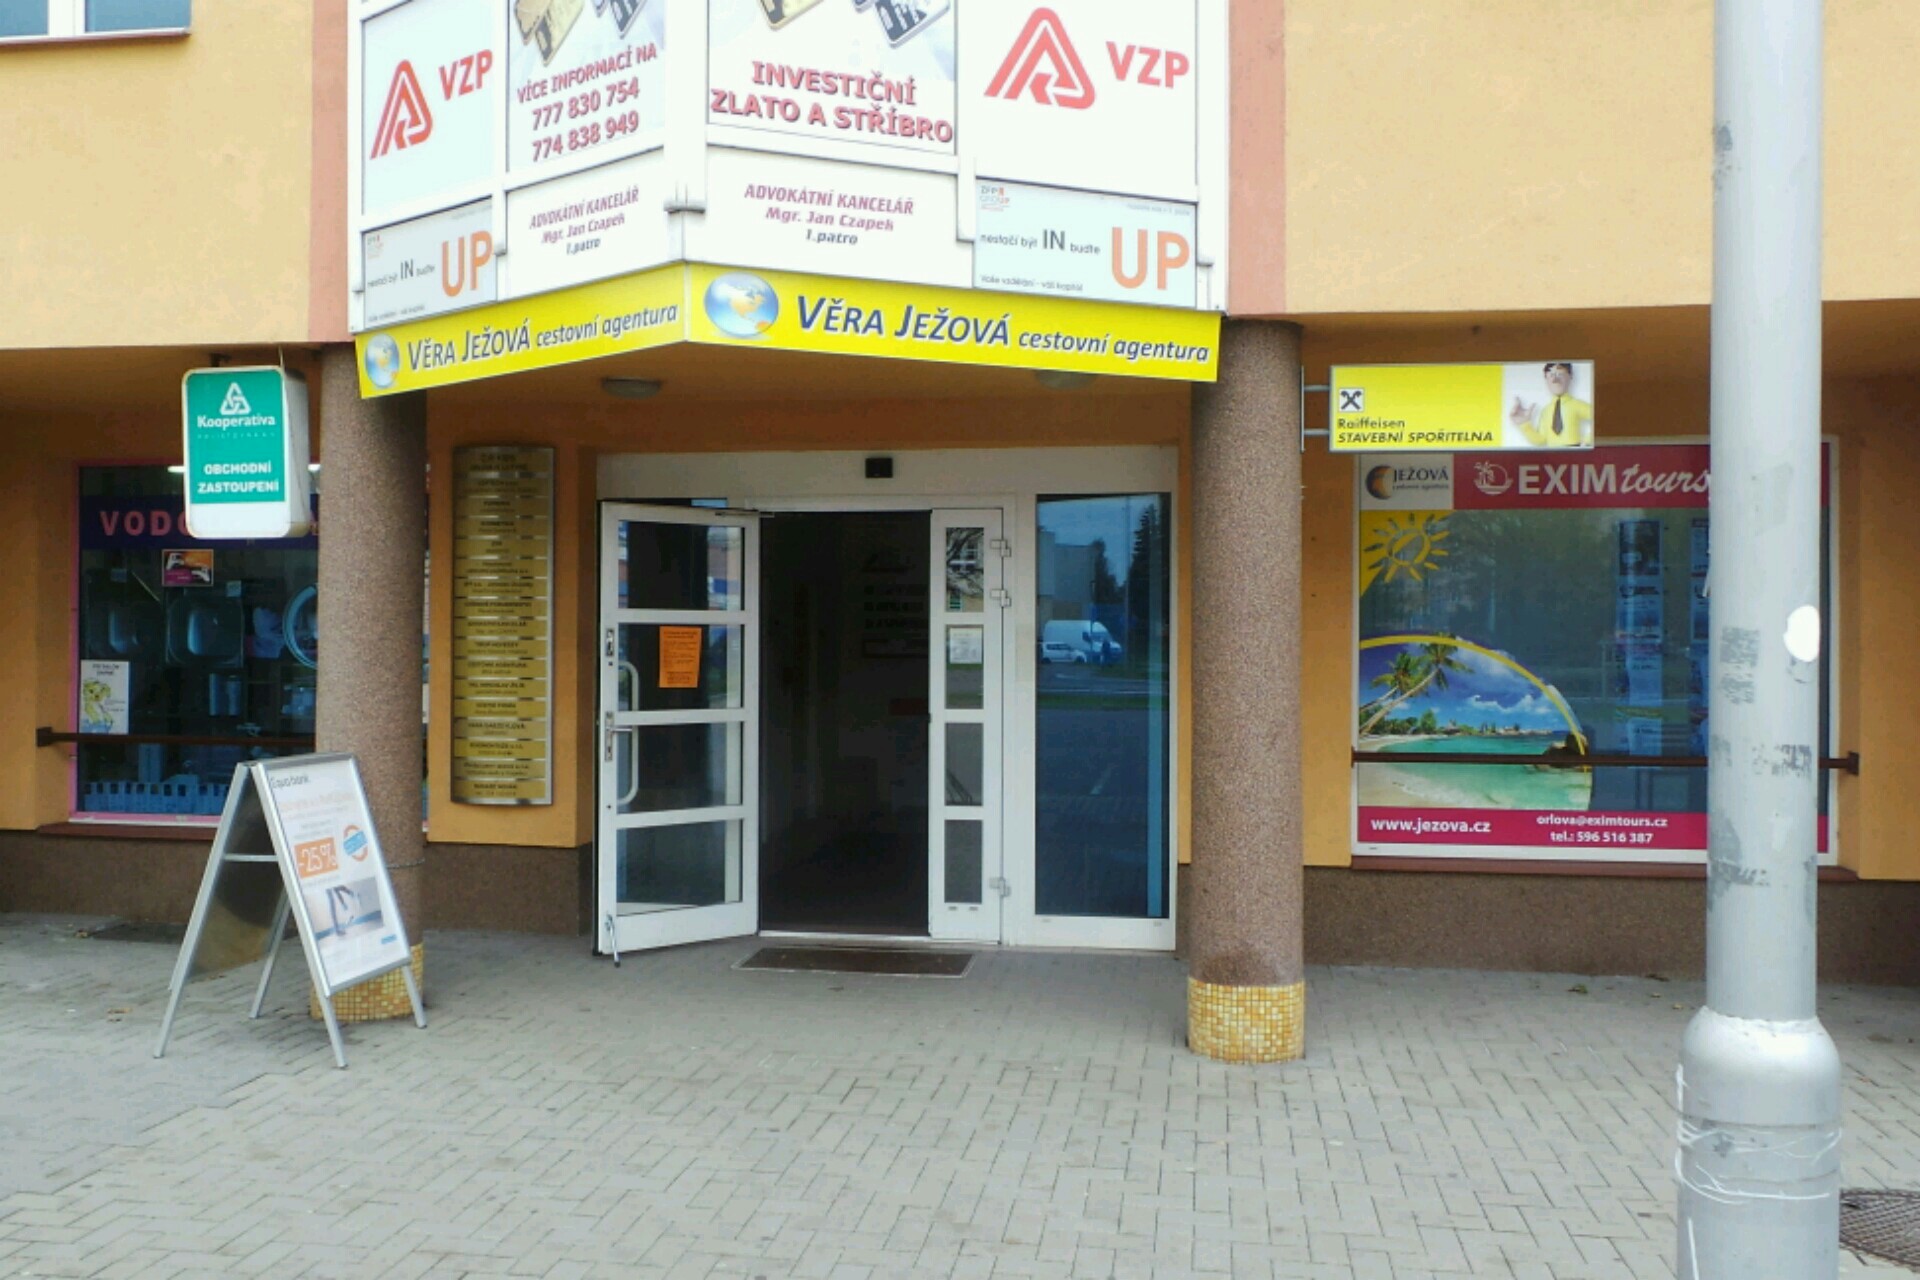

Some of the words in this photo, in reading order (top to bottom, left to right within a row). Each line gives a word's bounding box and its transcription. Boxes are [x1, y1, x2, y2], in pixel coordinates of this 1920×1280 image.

[438, 49, 493, 101] VZP
[517, 79, 548, 104] VÍCE
[551, 44, 632, 93] INFORMACÍ
[636, 42, 657, 64] NA
[751, 60, 917, 105] INVESTIČNÍ
[1105, 41, 1190, 89] VZP
[532, 101, 563, 131] 777
[568, 89, 601, 119] 830
[606, 76, 640, 107] 754
[710, 88, 800, 122] ZLATO
[807, 103, 827, 126] A
[833, 102, 953, 143] STŘÍBRO
[532, 134, 563, 162] 774
[568, 122, 601, 151] 838
[605, 110, 640, 139] 949
[529, 200, 585, 229] ADVOKÁTNÍ
[586, 184, 639, 215] KANCELÁŘ
[744, 183, 833, 206] ADVOKÁTNÍ
[837, 193, 914, 214] KANCELÁŘ
[566, 224, 585, 238] Jan
[765, 206, 801, 223] Mgr.
[806, 211, 834, 226] Jan
[839, 213, 894, 231] Czapek
[400, 258, 414, 280] IN
[441, 230, 493, 297] UP
[1042, 229, 1065, 250] IN
[1111, 226, 1190, 291] UP
[408, 340, 456, 371] VĚRA
[461, 318, 531, 362] JEŽOVÁ
[537, 317, 598, 347] cestovní
[602, 304, 678, 337] agentura
[797, 295, 884, 335] VĚRA
[894, 304, 1009, 346] JEŽOVÁ
[1019, 329, 1108, 354] cestovní
[1113, 338, 1209, 362] agentura
[197, 413, 276, 431] Kooperativa
[1338, 417, 1405, 430] Raiffeisen
[1338, 431, 1404, 443] STAVEBNÍ
[1408, 429, 1493, 443] SPOŘITELNA
[197, 478, 279, 494] ZASTOUPENÍ
[203, 460, 272, 475] OBCHODNÍ
[1394, 466, 1449, 482] JEŽOVÁ
[1371, 818, 1491, 834] www.jezova.cz
[1536, 814, 1668, 828] orlova@eximtours.cz
[1576, 831, 1600, 843] 596
[1603, 832, 1626, 843] 516
[1628, 832, 1653, 844] 387
